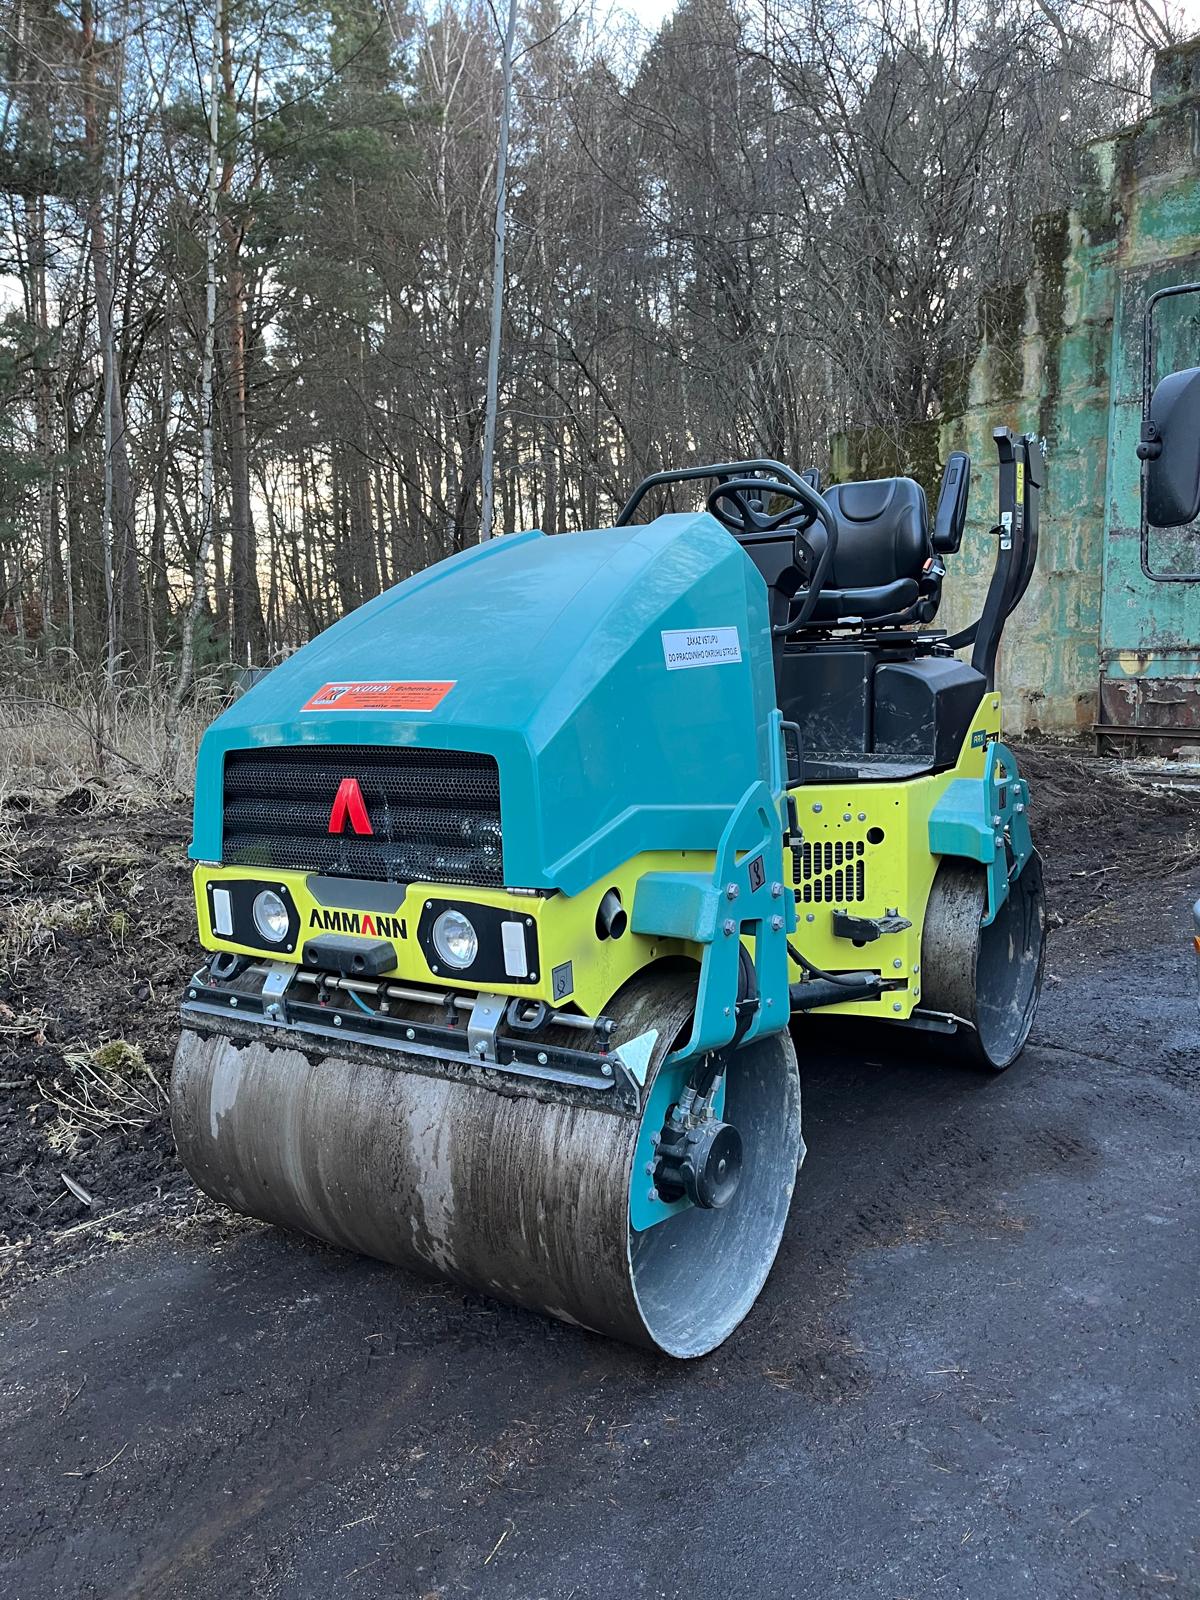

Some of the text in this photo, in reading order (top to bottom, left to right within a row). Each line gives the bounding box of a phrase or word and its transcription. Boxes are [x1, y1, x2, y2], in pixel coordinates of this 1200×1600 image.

[687, 634, 702, 646] ZÁKAZ
[668, 653, 676, 662] DO
[309, 908, 408, 940] AMMANN
